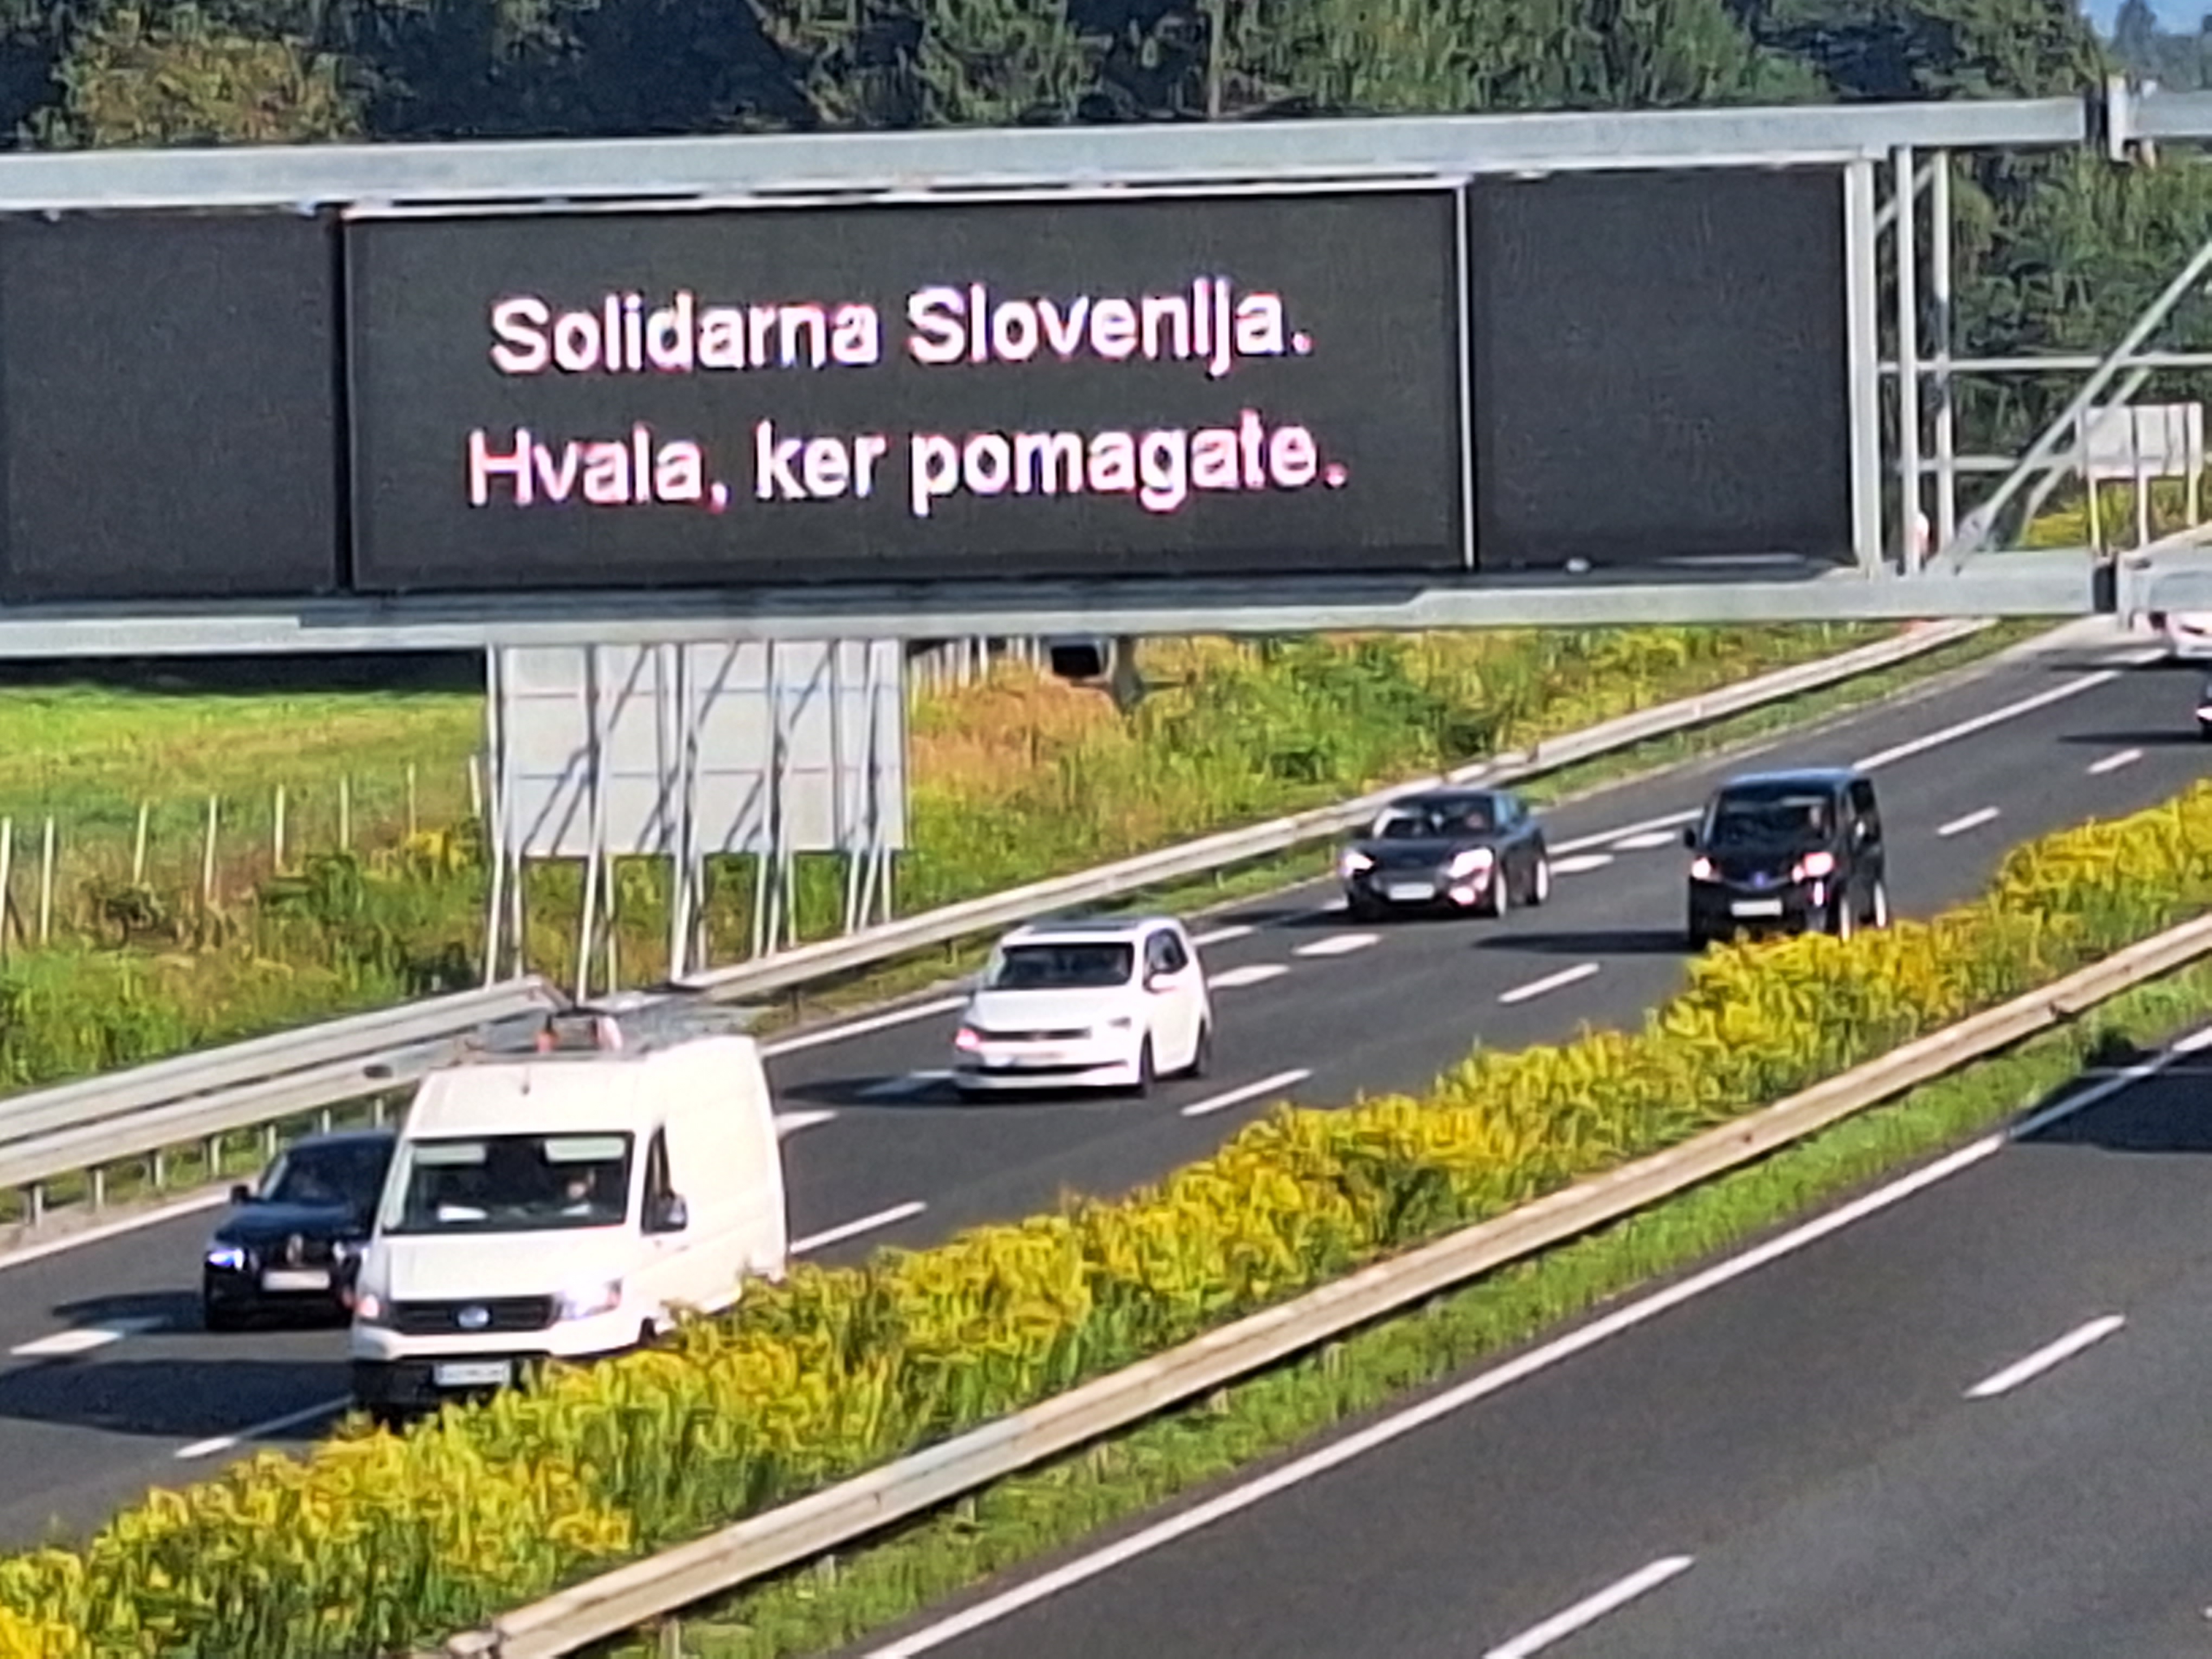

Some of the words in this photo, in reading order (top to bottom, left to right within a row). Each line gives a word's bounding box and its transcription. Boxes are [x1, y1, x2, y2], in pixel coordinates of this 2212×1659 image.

[491, 291, 879, 372] Solidarna
[907, 276, 1311, 376] Slovenija.
[470, 423, 728, 511] Hvala,
[756, 420, 886, 499] ker
[912, 409, 1346, 517] pomagate.
